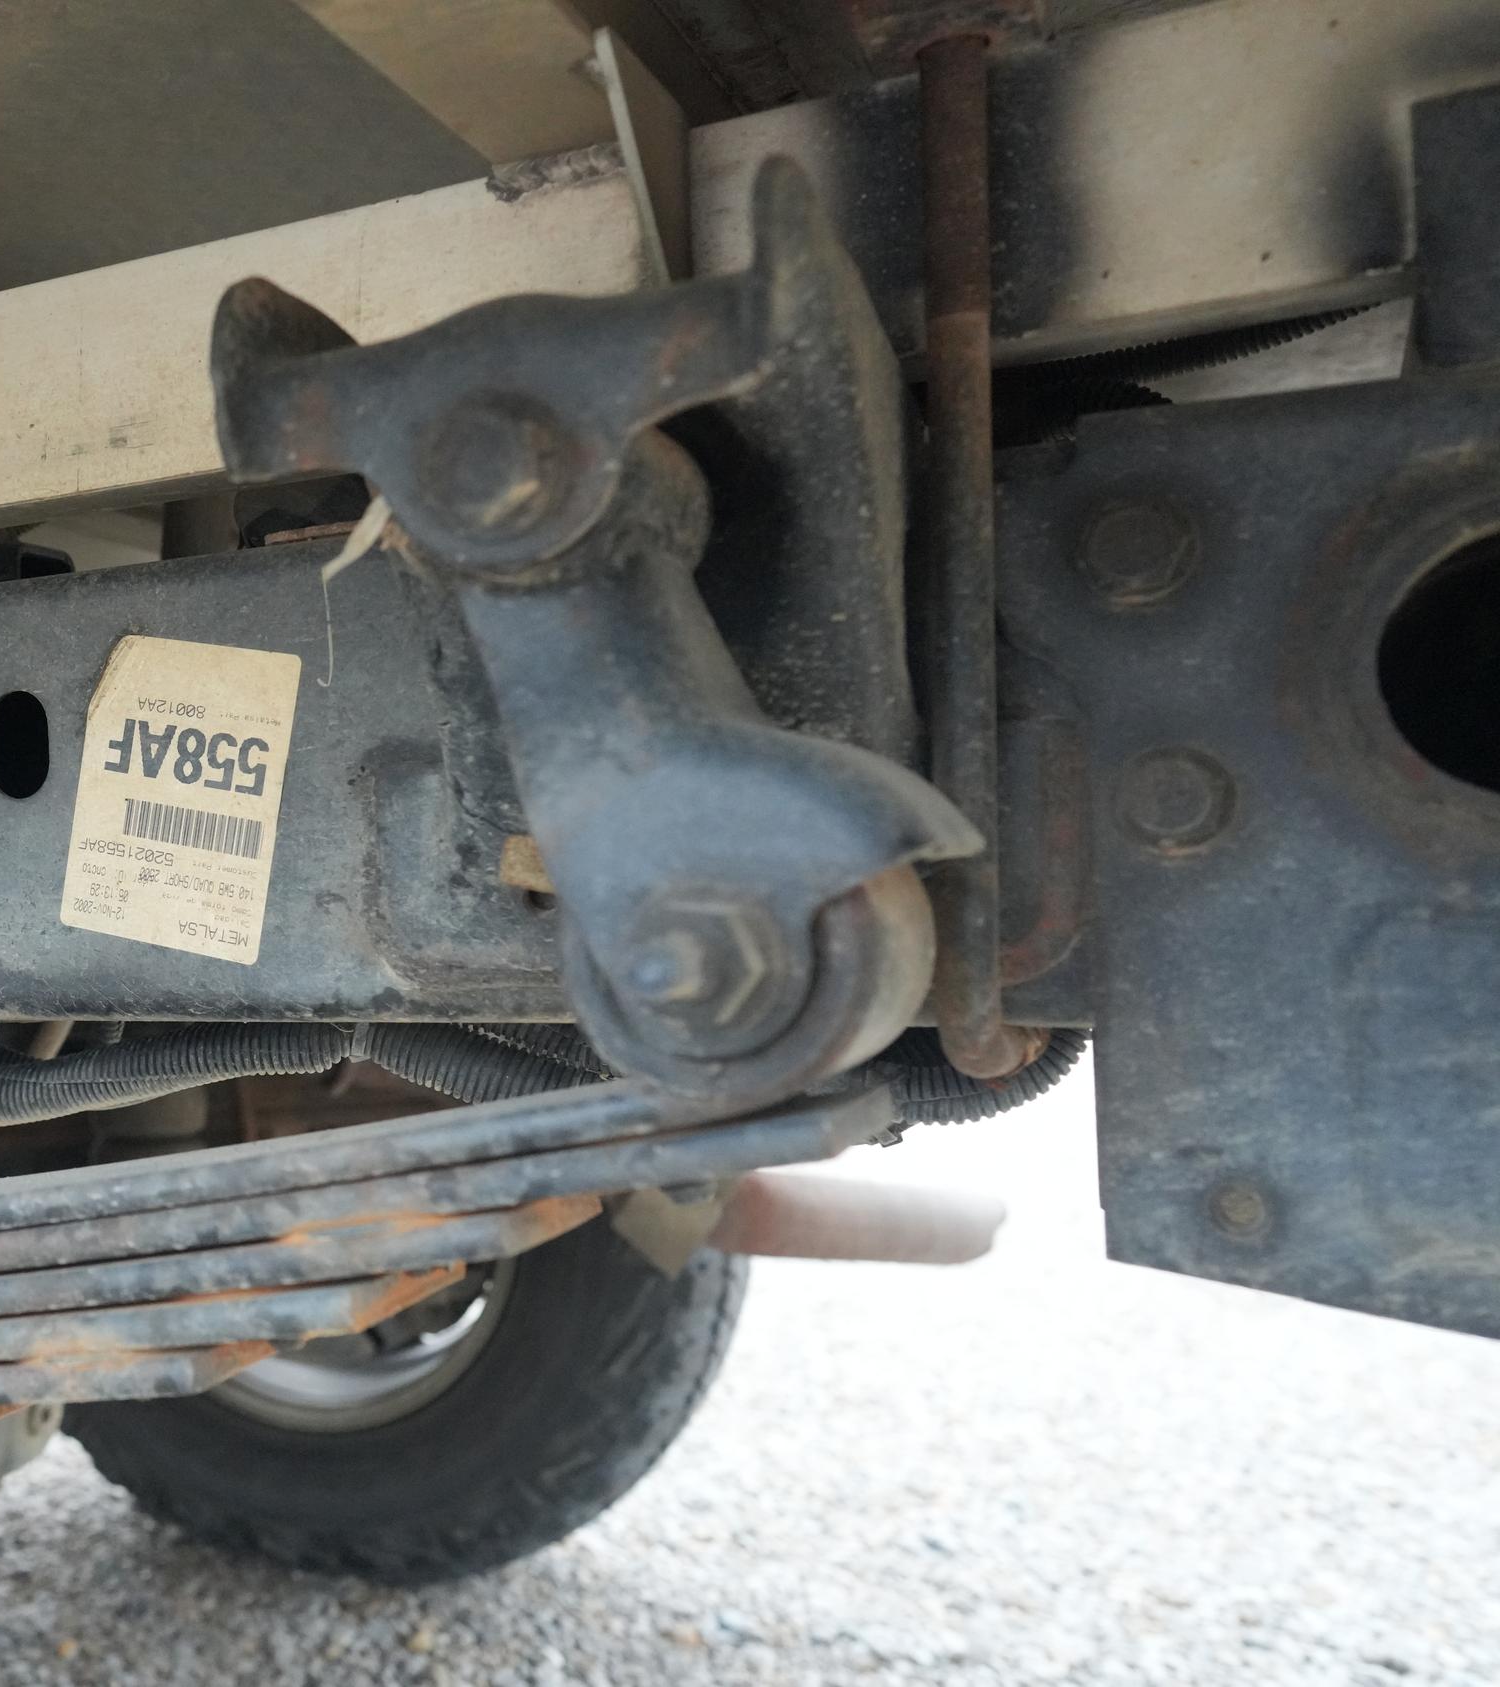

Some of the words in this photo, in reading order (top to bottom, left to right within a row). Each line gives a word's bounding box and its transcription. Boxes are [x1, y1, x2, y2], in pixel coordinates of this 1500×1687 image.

[138, 697, 205, 719] 80012AA
[104, 719, 269, 796] 558AF
[78, 838, 174, 867] 52021558AF
[163, 872, 214, 893] QUAD/SHORT
[218, 868, 257, 879] Customer
[90, 883, 129, 902] 05:13:29
[73, 898, 125, 920] 12-Nov-2002
[178, 920, 248, 947] METALSA
